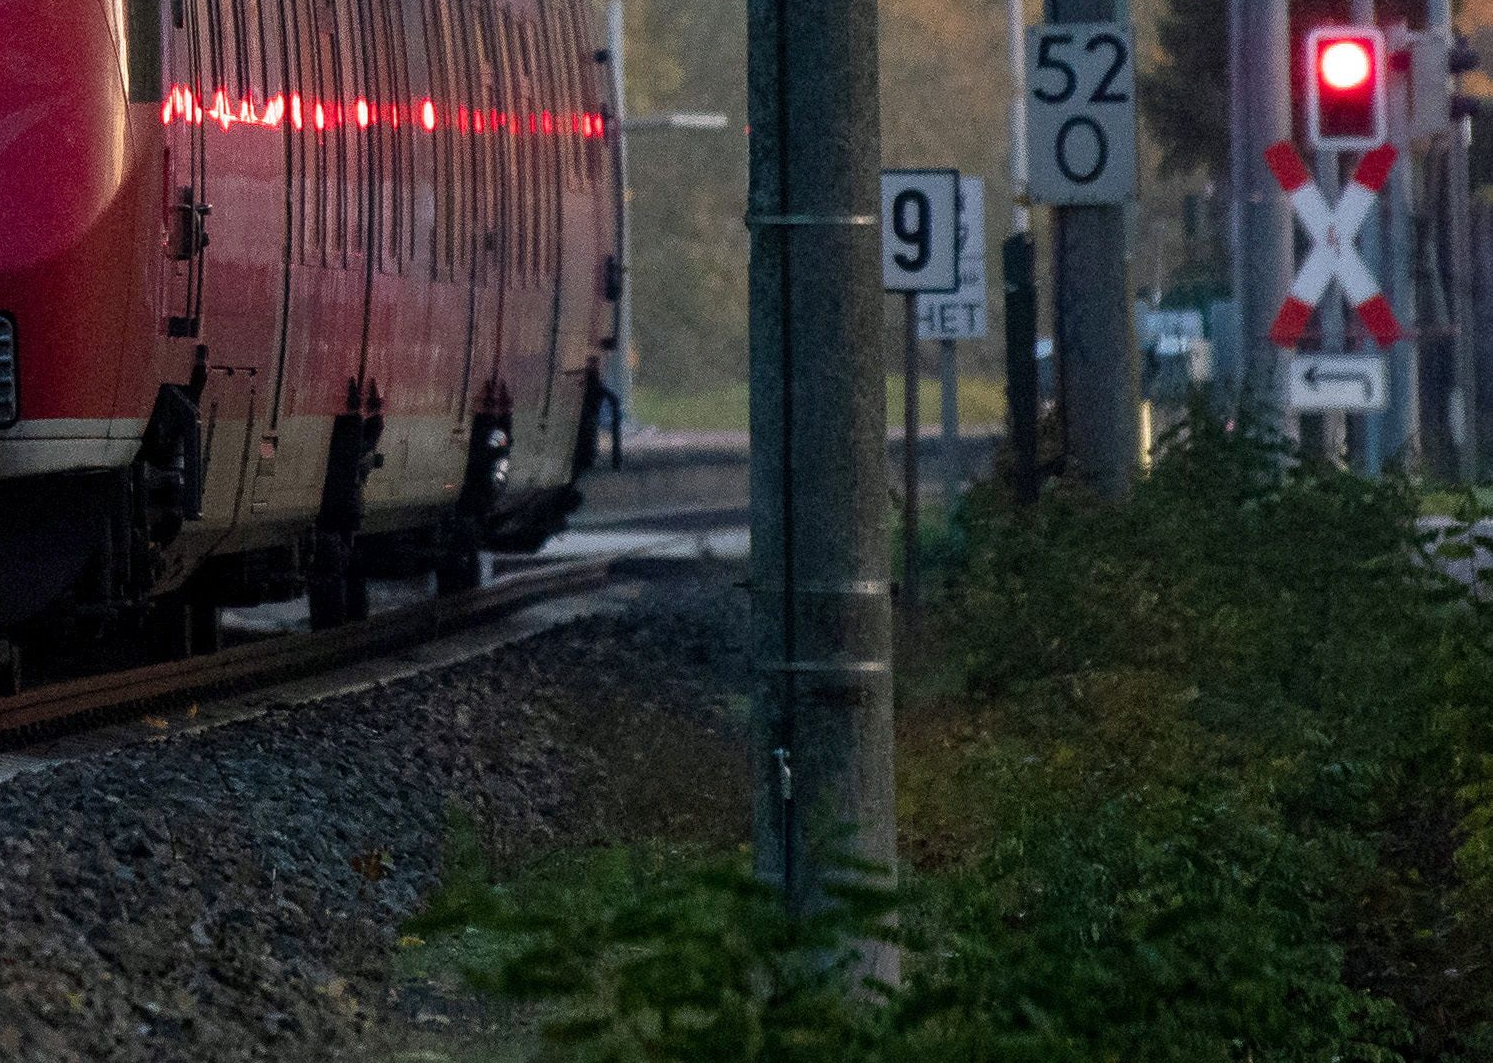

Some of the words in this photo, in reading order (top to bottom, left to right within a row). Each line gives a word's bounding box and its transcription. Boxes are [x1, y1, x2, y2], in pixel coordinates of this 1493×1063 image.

[1033, 34, 1129, 104] 52
[1055, 115, 1108, 184] 0
[892, 188, 931, 273] 9
